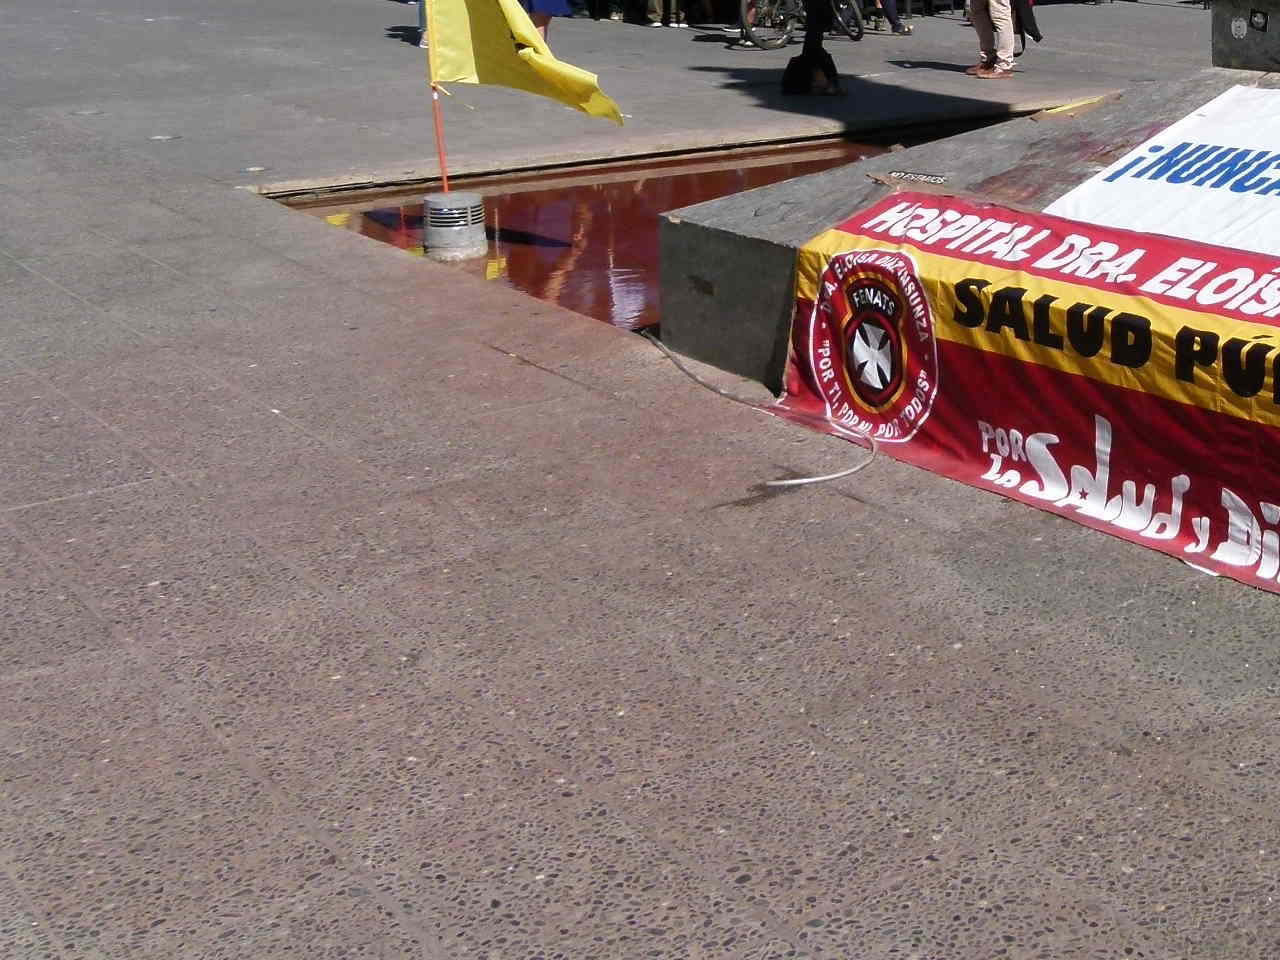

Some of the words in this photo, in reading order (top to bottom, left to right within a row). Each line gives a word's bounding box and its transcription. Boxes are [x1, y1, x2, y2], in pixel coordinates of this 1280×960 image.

[860, 201, 1051, 262] HOSPITAL
[1031, 233, 1146, 284] DRA.
[852, 288, 896, 316] FENATS
[953, 278, 1152, 369] SALUD
[978, 421, 1028, 462] POR
